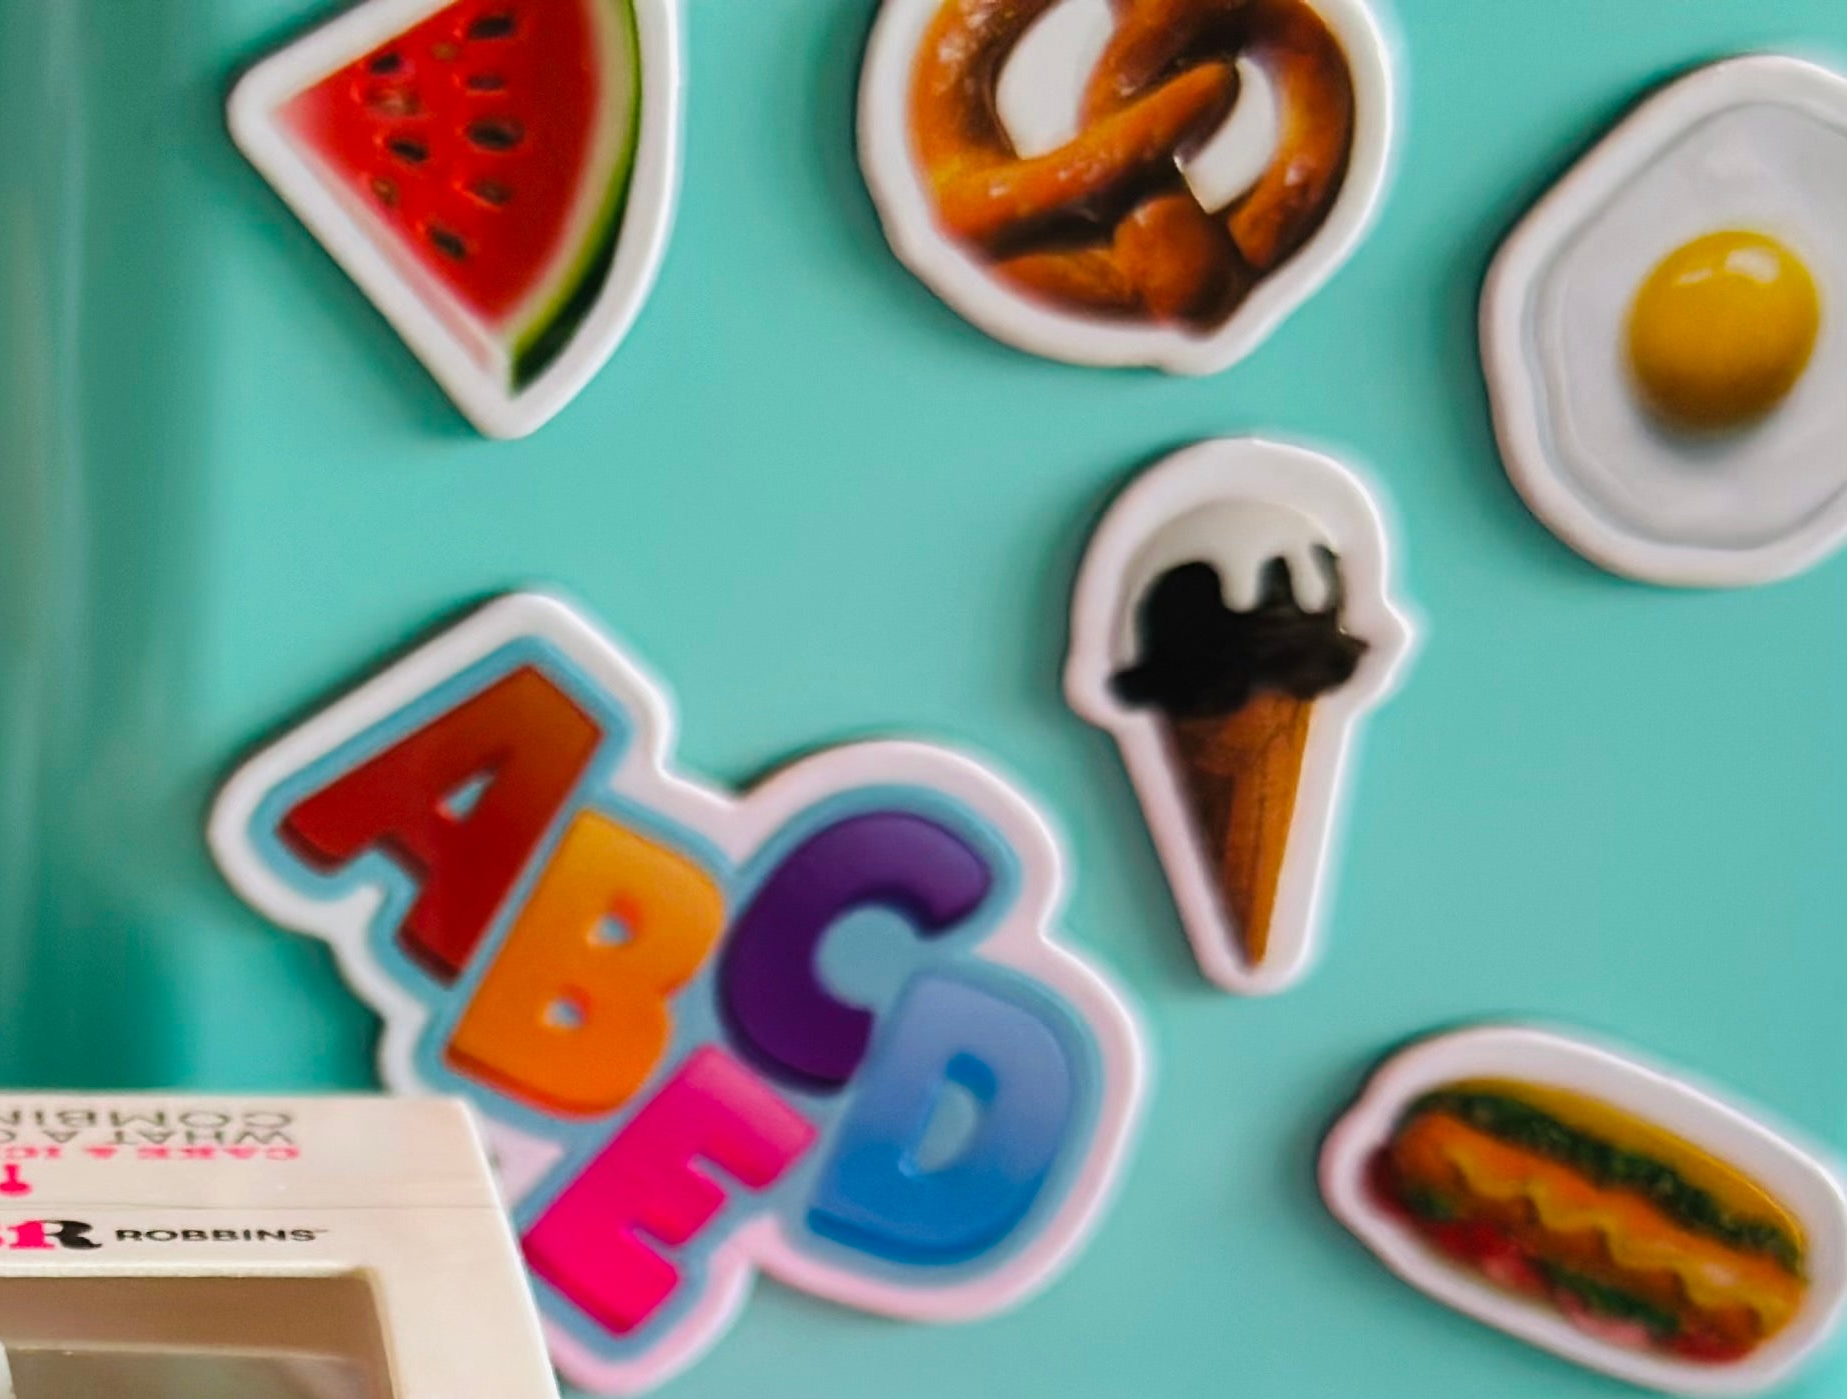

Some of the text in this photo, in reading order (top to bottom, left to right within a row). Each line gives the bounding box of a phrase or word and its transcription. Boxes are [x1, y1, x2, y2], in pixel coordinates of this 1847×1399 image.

[42, 1128, 80, 1145] A
[104, 1129, 295, 1146] WHAT
[136, 1145, 301, 1160] CAKE
[114, 1228, 317, 1243] ROBBINS
